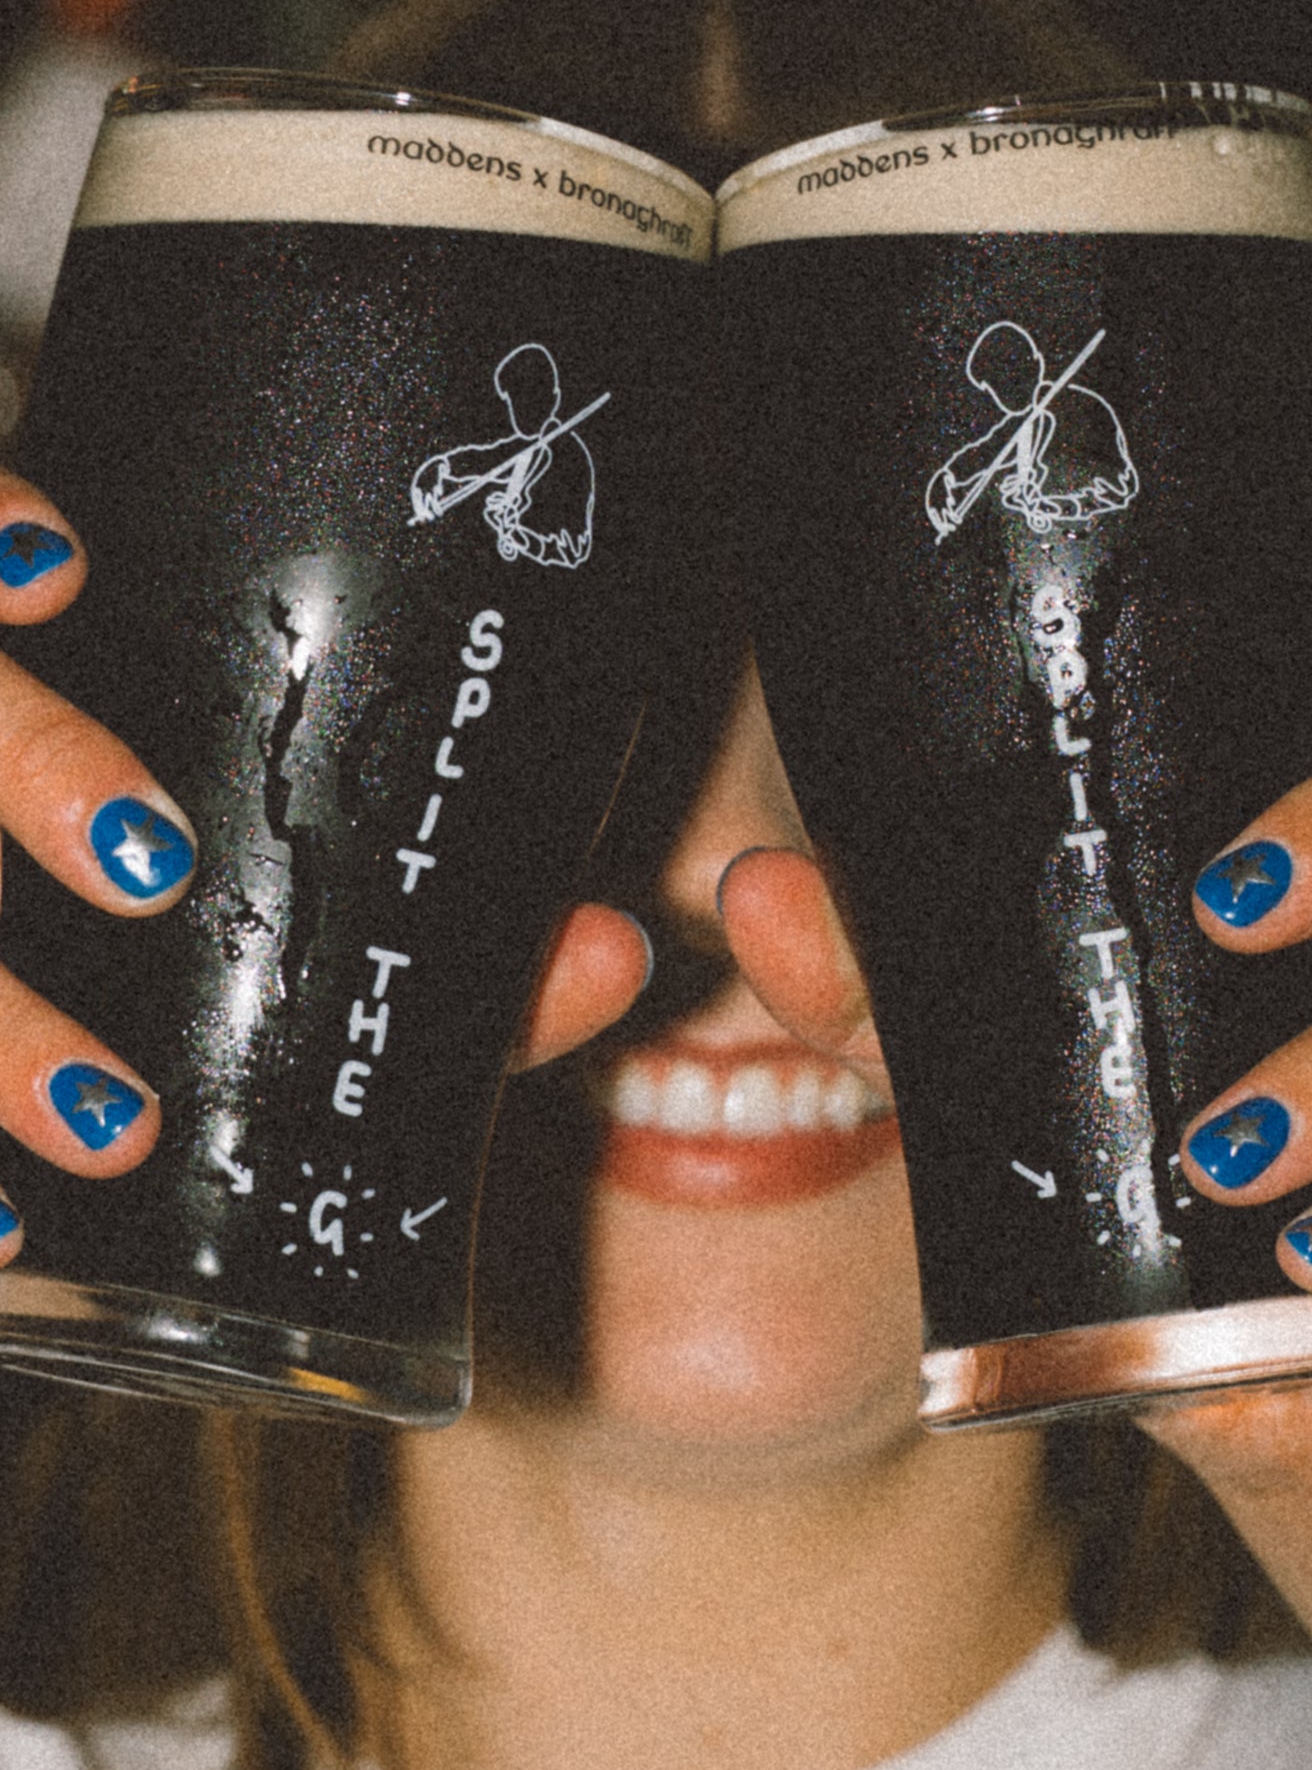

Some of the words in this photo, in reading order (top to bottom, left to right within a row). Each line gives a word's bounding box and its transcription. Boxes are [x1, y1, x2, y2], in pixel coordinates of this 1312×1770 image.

[367, 134, 522, 183] maddens
[532, 167, 548, 189] x
[797, 142, 929, 195] maddens
[941, 141, 958, 160] x
[397, 610, 504, 894] SPLIT
[1030, 584, 1107, 876] SPLIT
[1079, 928, 1138, 1100] THE
[332, 945, 412, 1117] THE
[308, 1190, 348, 1257] G
